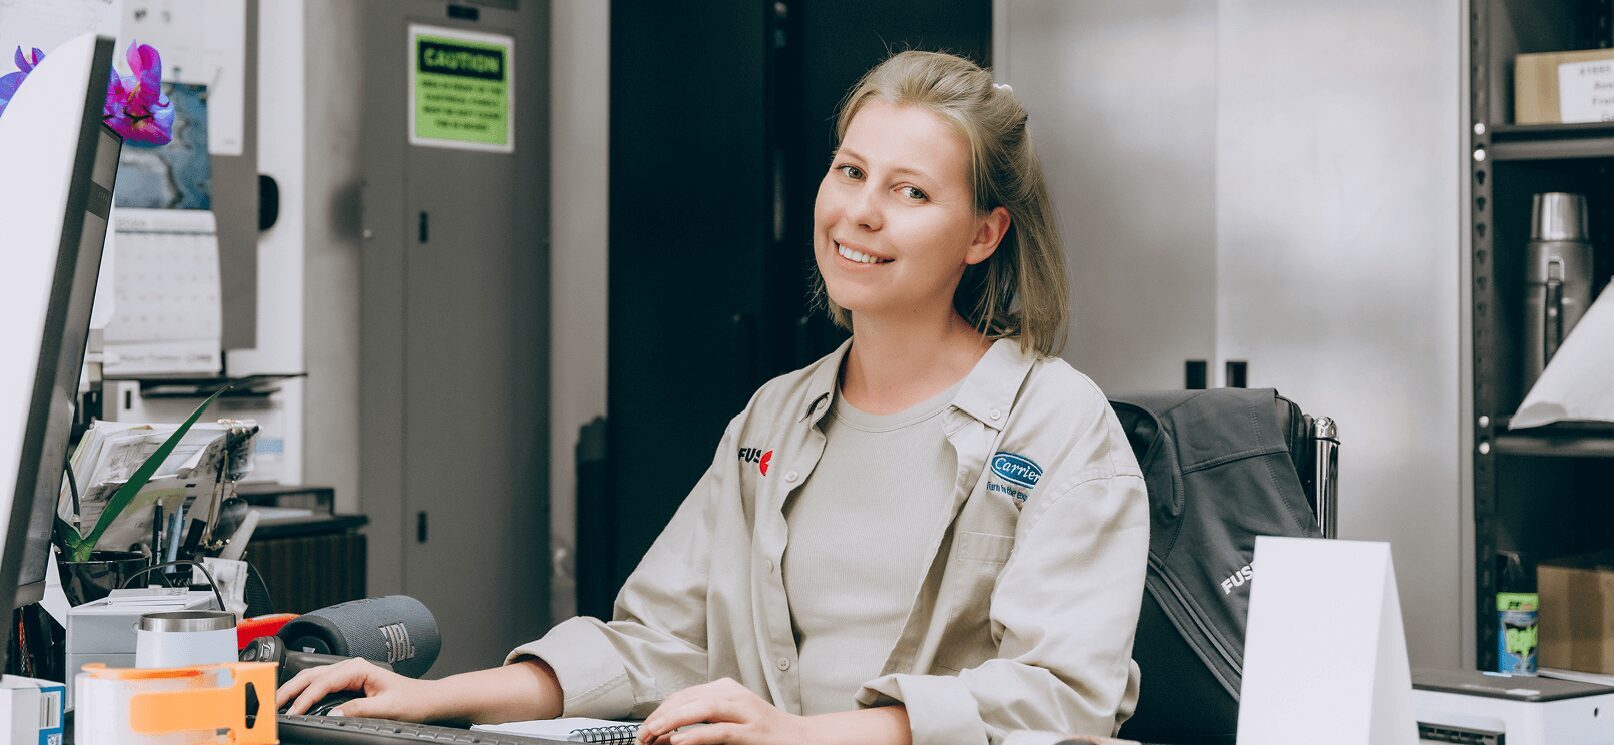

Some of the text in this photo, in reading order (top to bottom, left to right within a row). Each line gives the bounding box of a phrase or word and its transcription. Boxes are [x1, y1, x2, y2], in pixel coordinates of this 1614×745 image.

[424, 48, 500, 73] CAUTION
[995, 457, 1040, 482] Carrier
[1007, 486, 1017, 498] the
[1221, 560, 1255, 595] FUS
[379, 622, 415, 664] JBL
